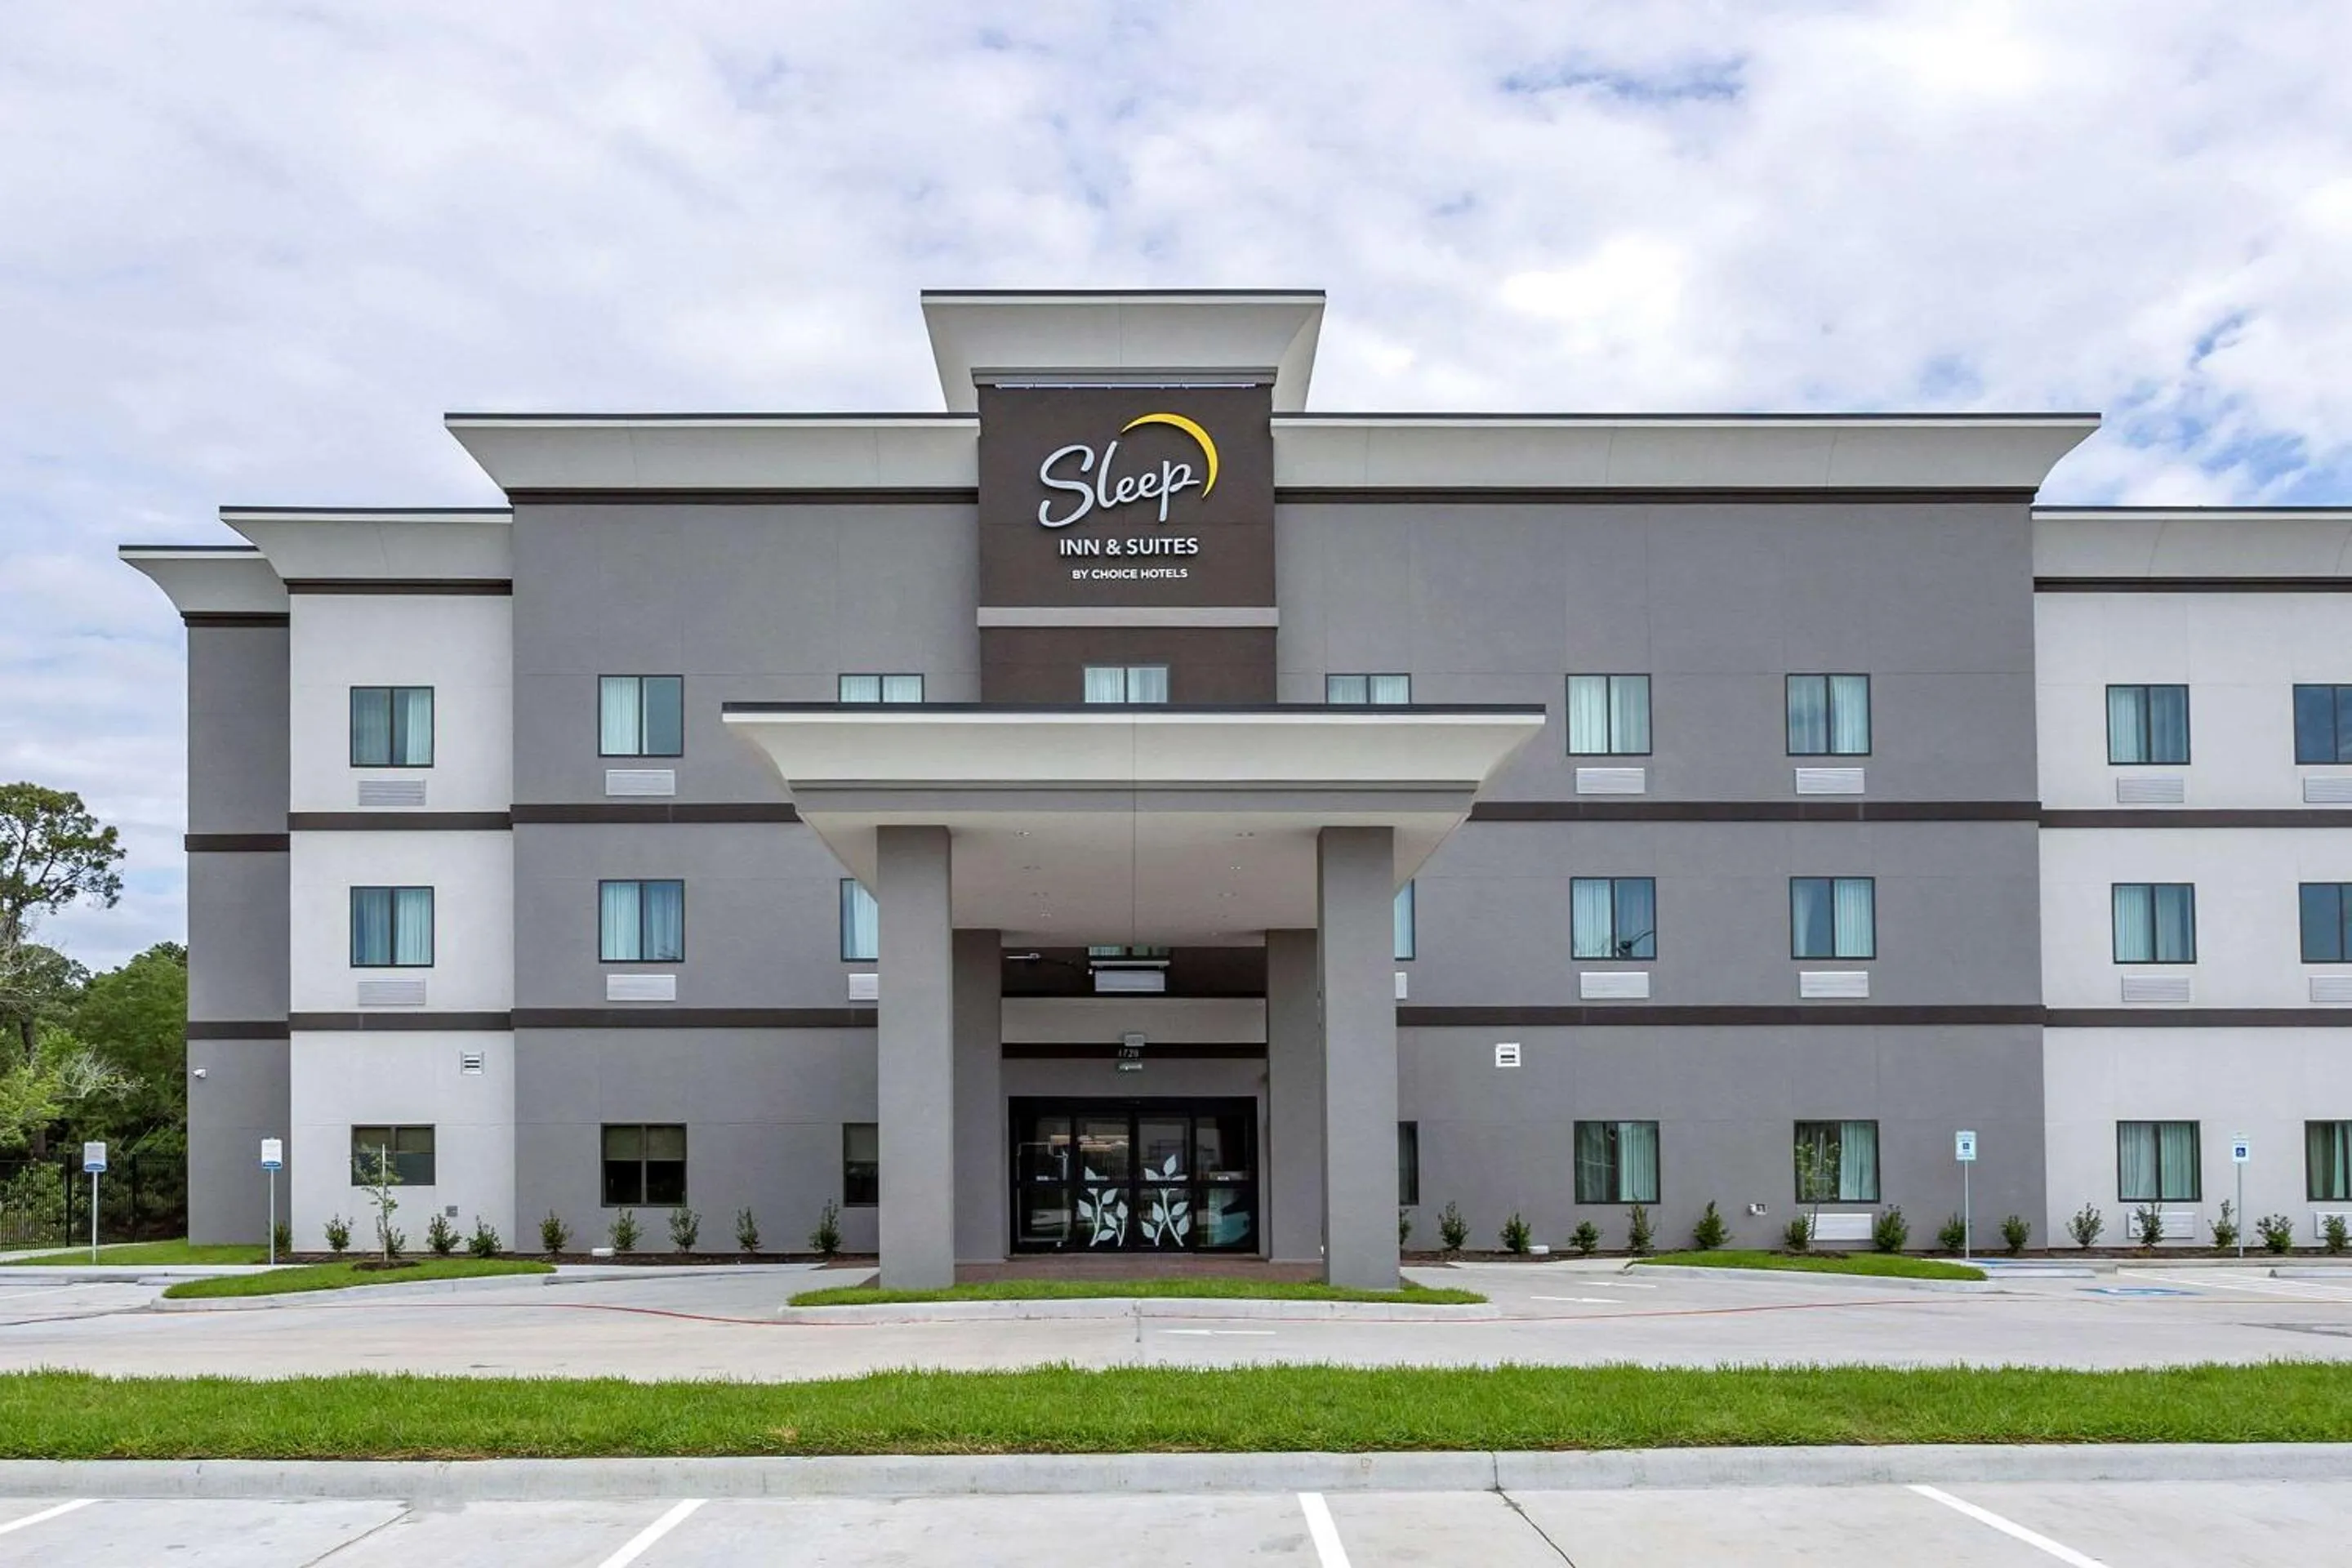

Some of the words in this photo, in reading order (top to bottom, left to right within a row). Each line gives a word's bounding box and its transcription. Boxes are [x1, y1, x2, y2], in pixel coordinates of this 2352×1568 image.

[1037, 440, 1200, 527] Sleep
[1059, 537, 1100, 555] INN
[1106, 537, 1121, 555] &
[1126, 537, 1199, 555] SUITES
[1071, 568, 1089, 580] BY
[1092, 568, 1138, 580] CHOICE
[1140, 568, 1188, 579] HOTELS
